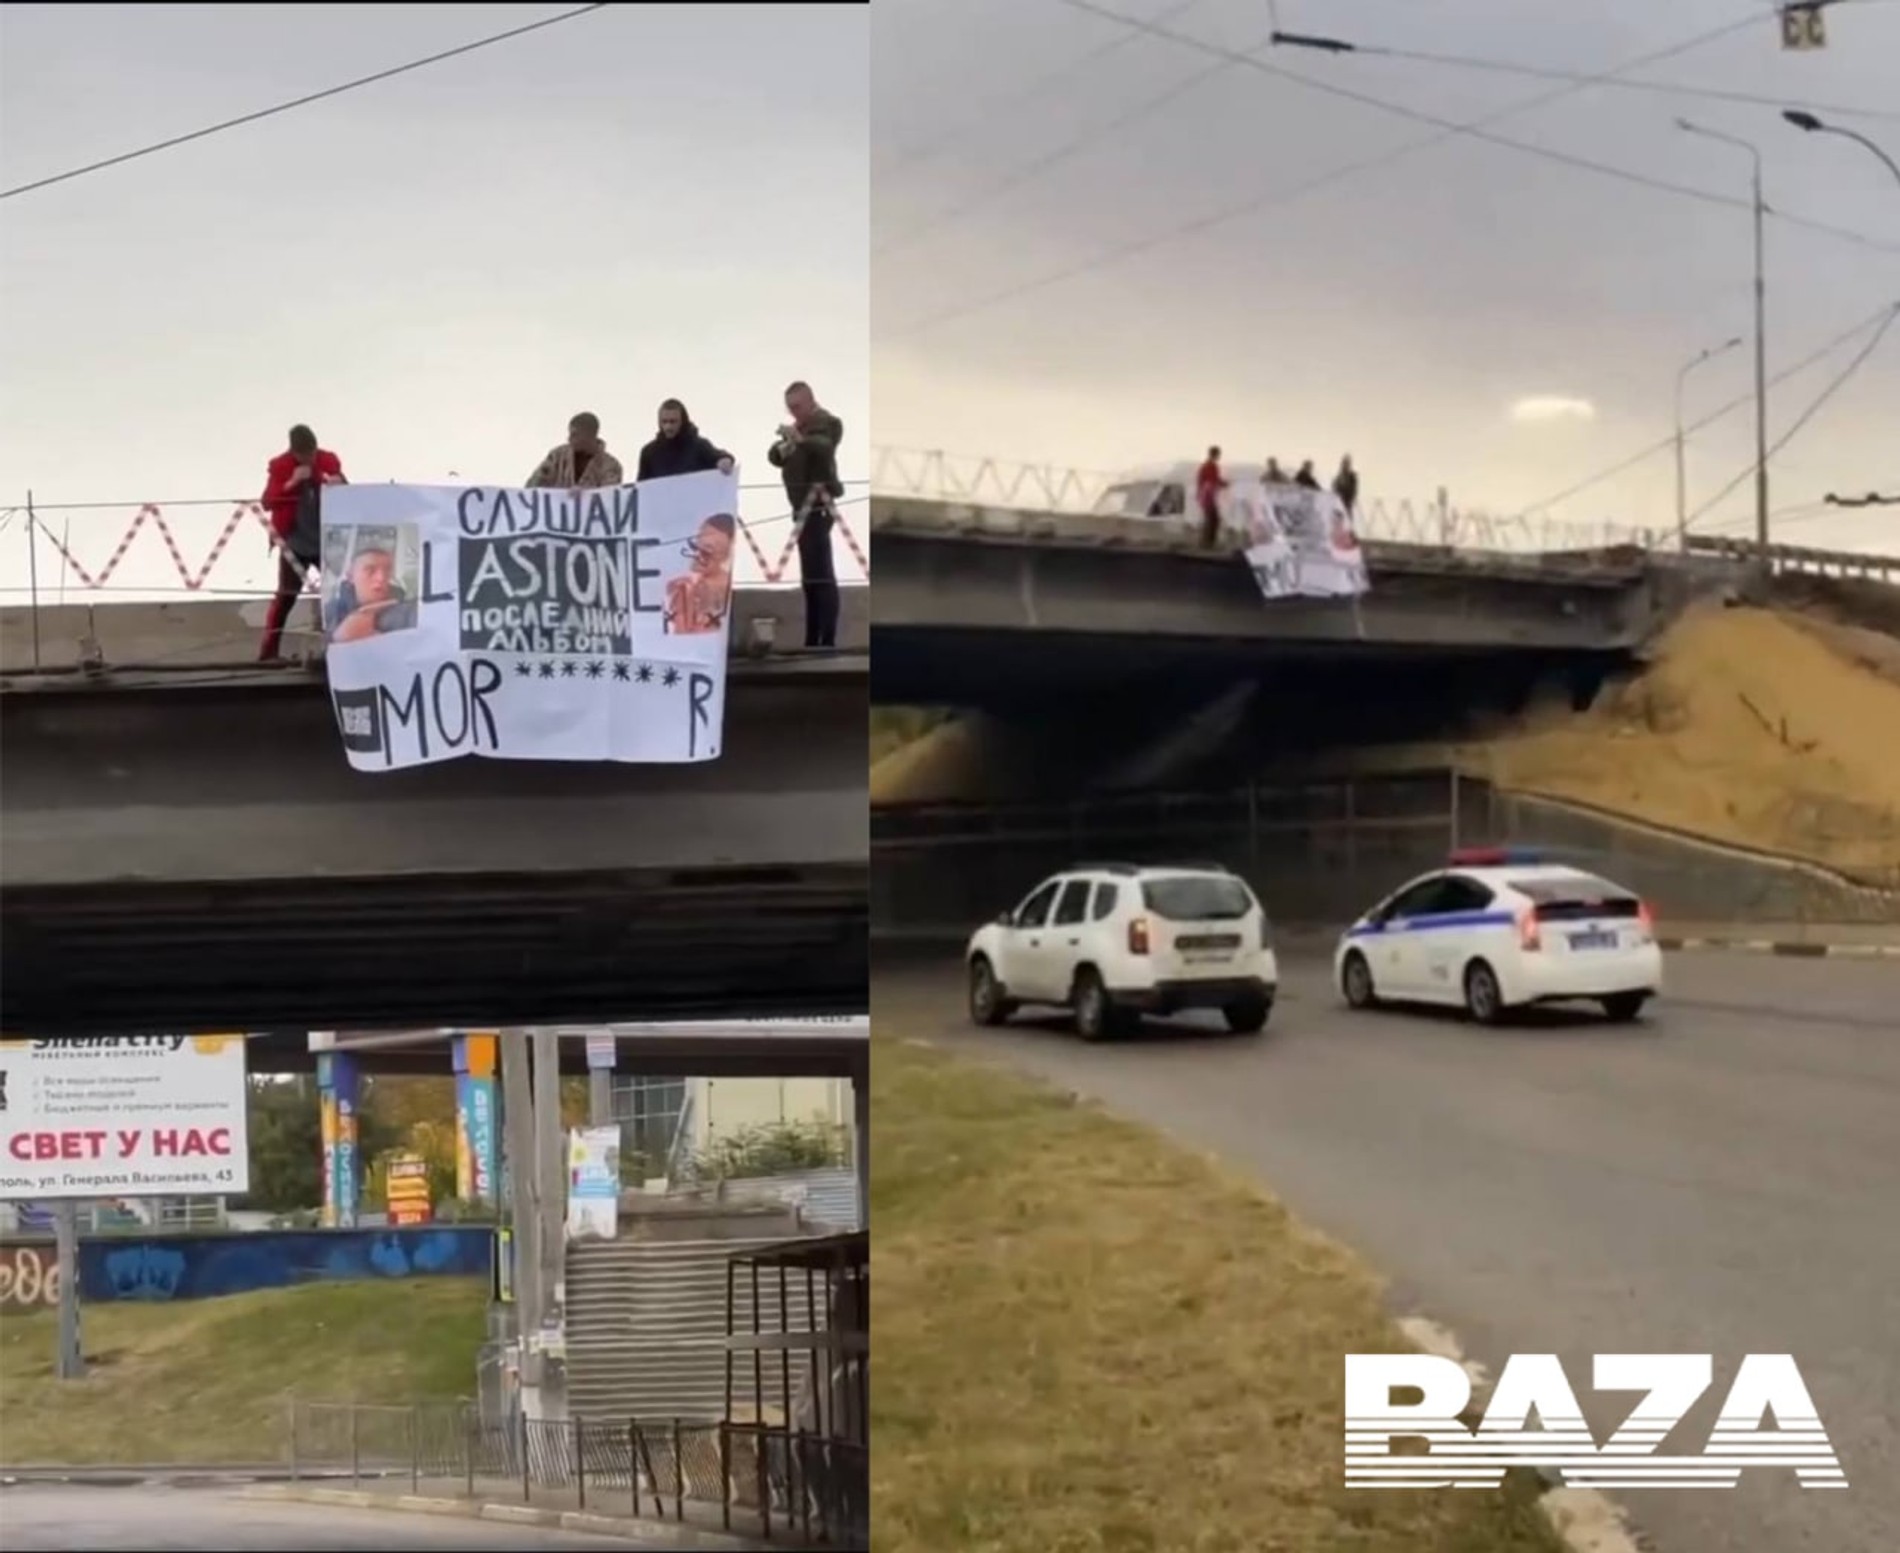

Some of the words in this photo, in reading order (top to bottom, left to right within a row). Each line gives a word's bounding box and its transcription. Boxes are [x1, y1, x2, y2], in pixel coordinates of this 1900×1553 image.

[457, 484, 639, 536] СЛУШАЙ
[9, 1132, 108, 1160] СВЕТ
[117, 1130, 142, 1158] У
[153, 1128, 231, 1157] НАС
[216, 1170, 233, 1181] 43
